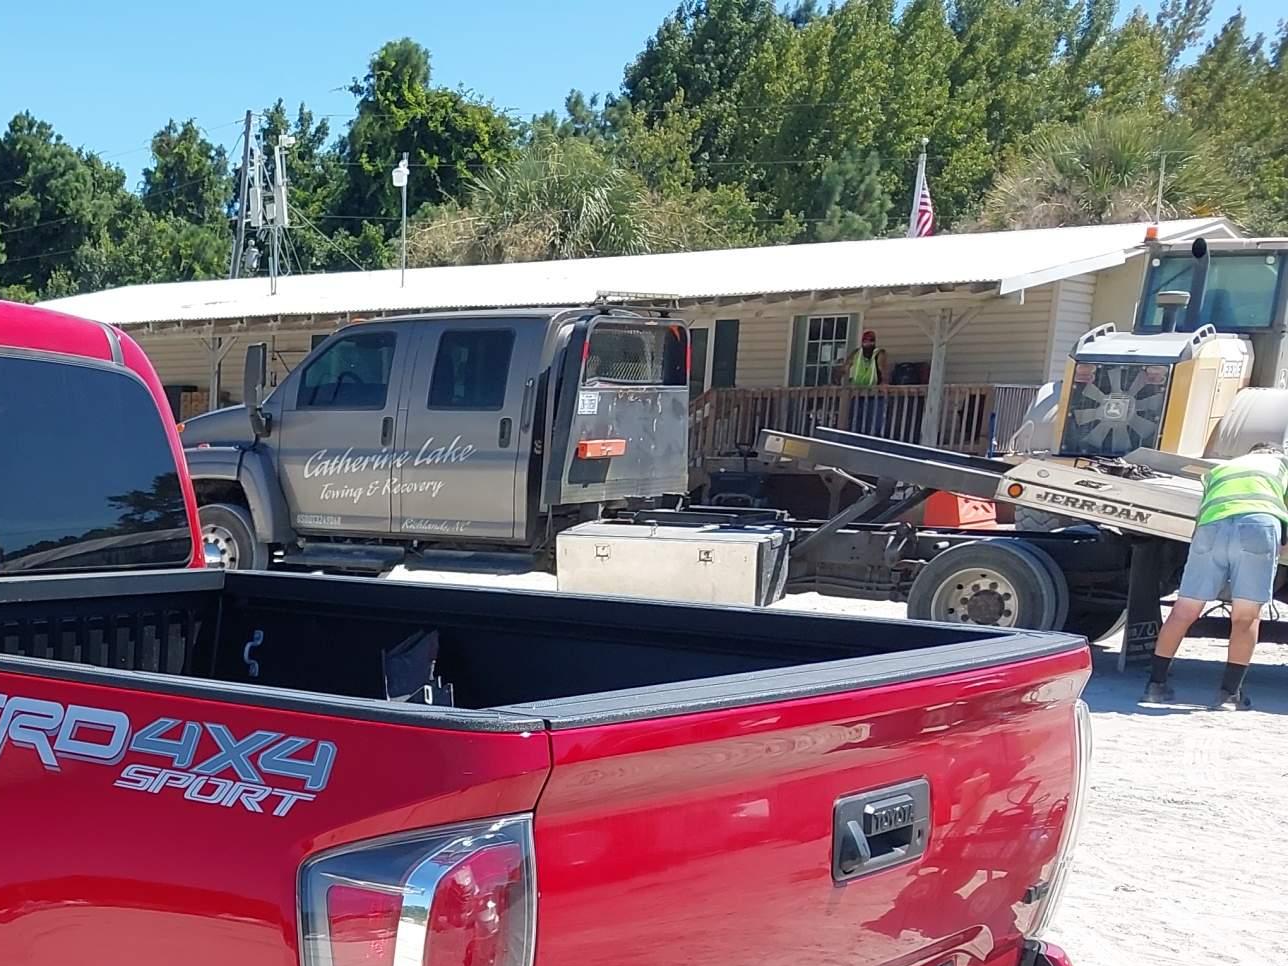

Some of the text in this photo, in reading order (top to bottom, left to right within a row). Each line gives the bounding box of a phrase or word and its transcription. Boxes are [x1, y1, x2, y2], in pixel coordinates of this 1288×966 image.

[304, 435, 477, 478] Catherine Lake
[320, 477, 446, 503] Towing & Recovery
[113, 764, 317, 817] SPORT
[872, 803, 913, 833] TOYOTA
